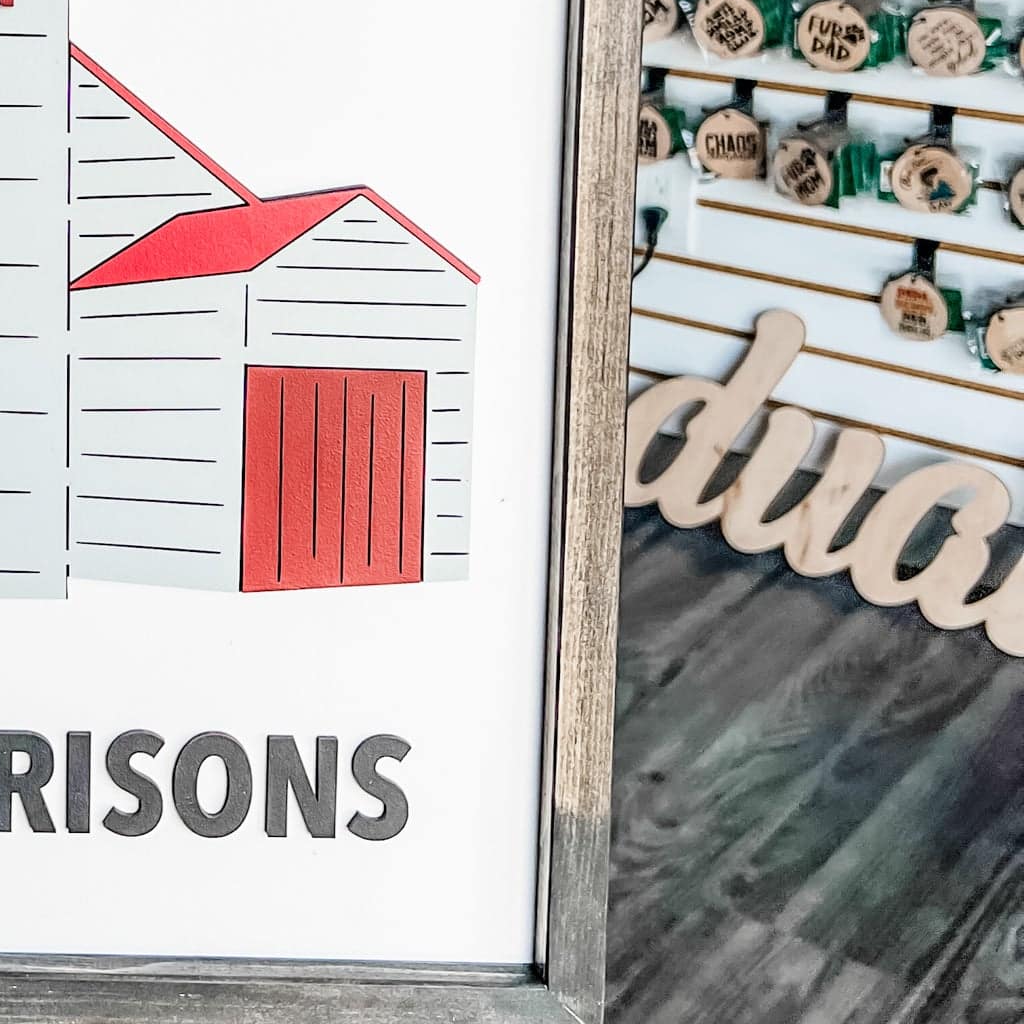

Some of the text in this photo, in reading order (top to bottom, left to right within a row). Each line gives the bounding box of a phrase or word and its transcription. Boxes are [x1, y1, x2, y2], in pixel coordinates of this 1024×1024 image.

[808, 16, 843, 43] FUR
[812, 37, 850, 60] DAD
[705, 133, 757, 157] CHAOS
